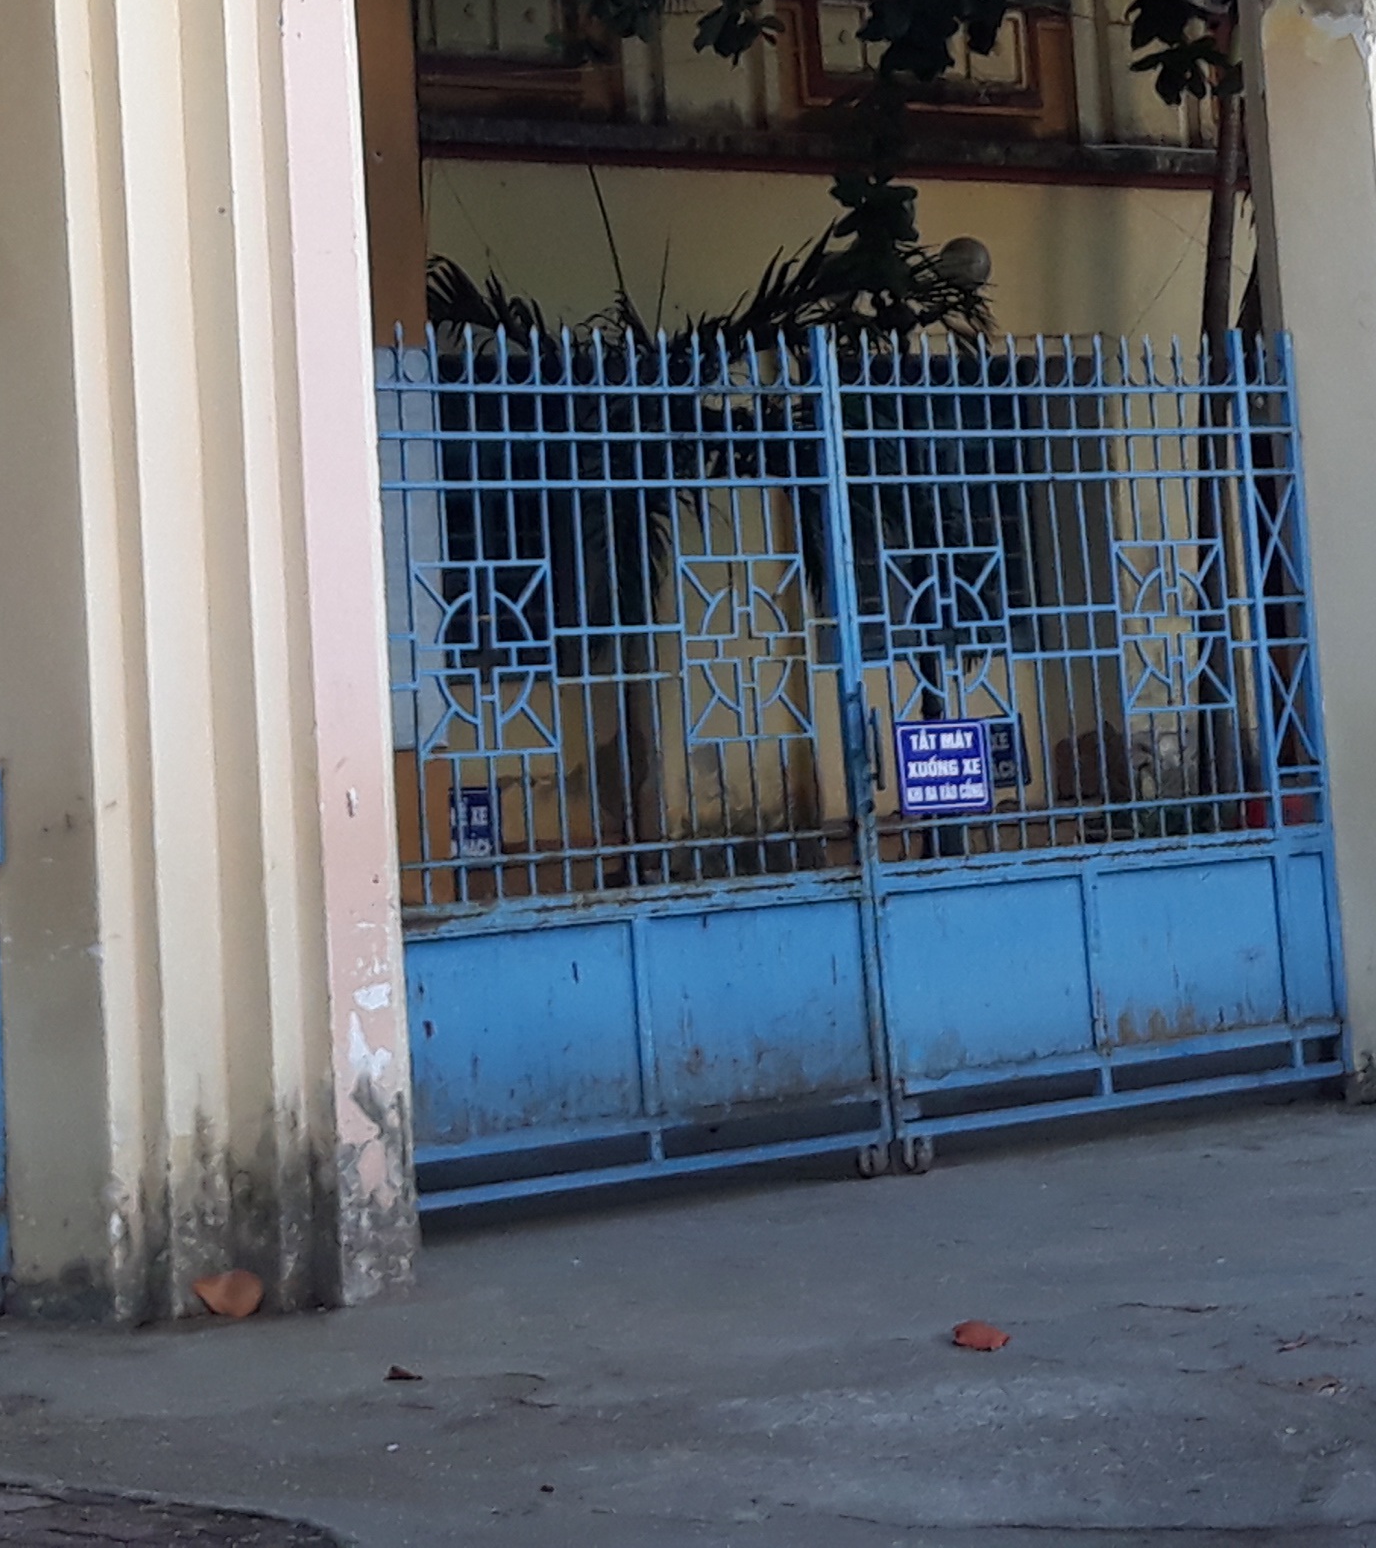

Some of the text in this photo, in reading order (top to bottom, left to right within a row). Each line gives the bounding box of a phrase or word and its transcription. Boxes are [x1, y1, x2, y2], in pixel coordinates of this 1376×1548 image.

[940, 729, 974, 750] MÁY
[907, 754, 959, 778] XUỐNG
[962, 757, 982, 775] XE
